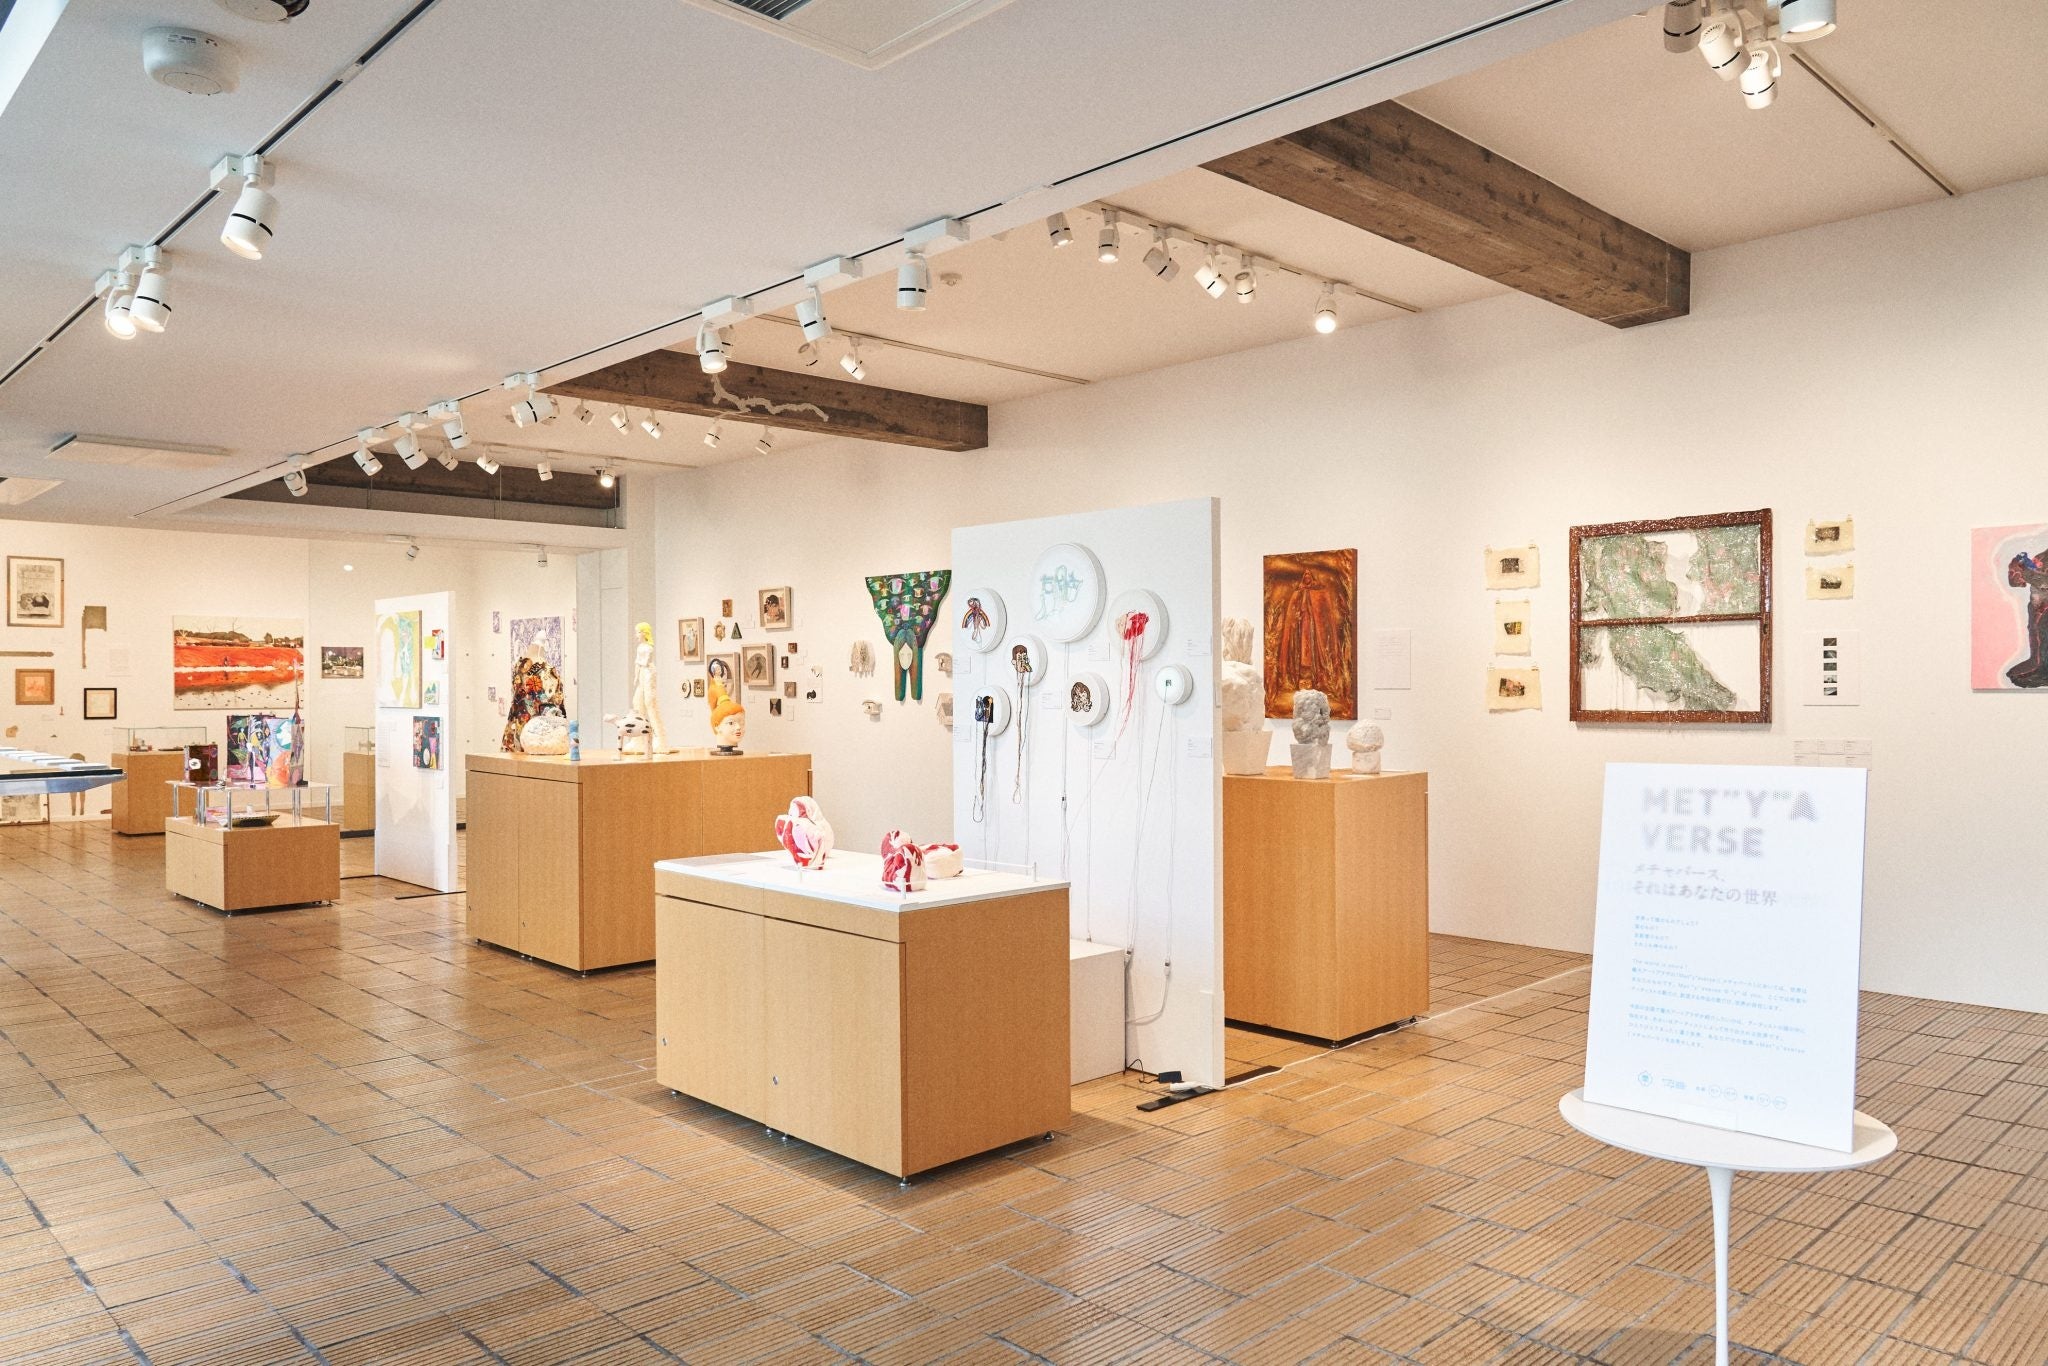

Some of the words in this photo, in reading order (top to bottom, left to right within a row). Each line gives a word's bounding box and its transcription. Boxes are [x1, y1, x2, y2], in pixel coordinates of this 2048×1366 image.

[1642, 823, 1763, 858] VERSE
[1632, 880, 1777, 906] それはあなたの世界
